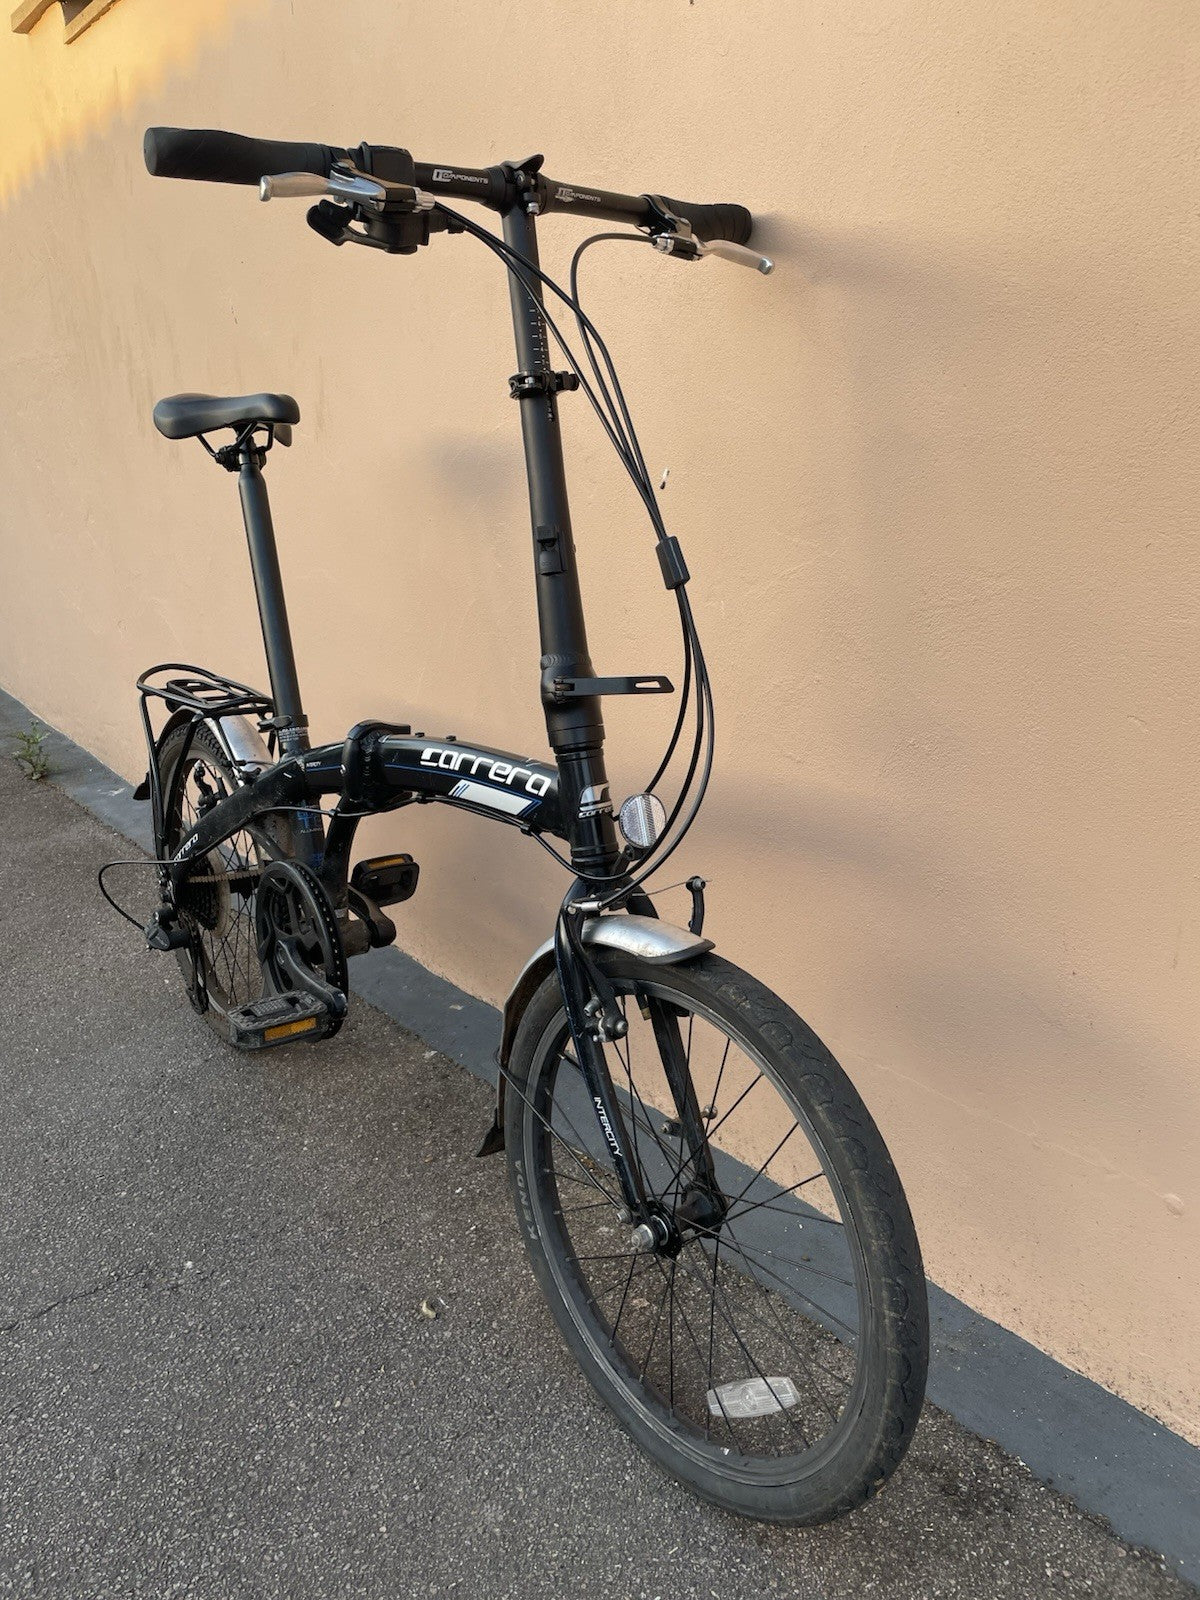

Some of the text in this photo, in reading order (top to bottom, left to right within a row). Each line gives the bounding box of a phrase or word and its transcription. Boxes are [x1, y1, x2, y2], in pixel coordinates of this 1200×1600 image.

[420, 748, 551, 797] carrera
[578, 806, 613, 819] carre
[593, 1096, 623, 1157] INTERCITY
